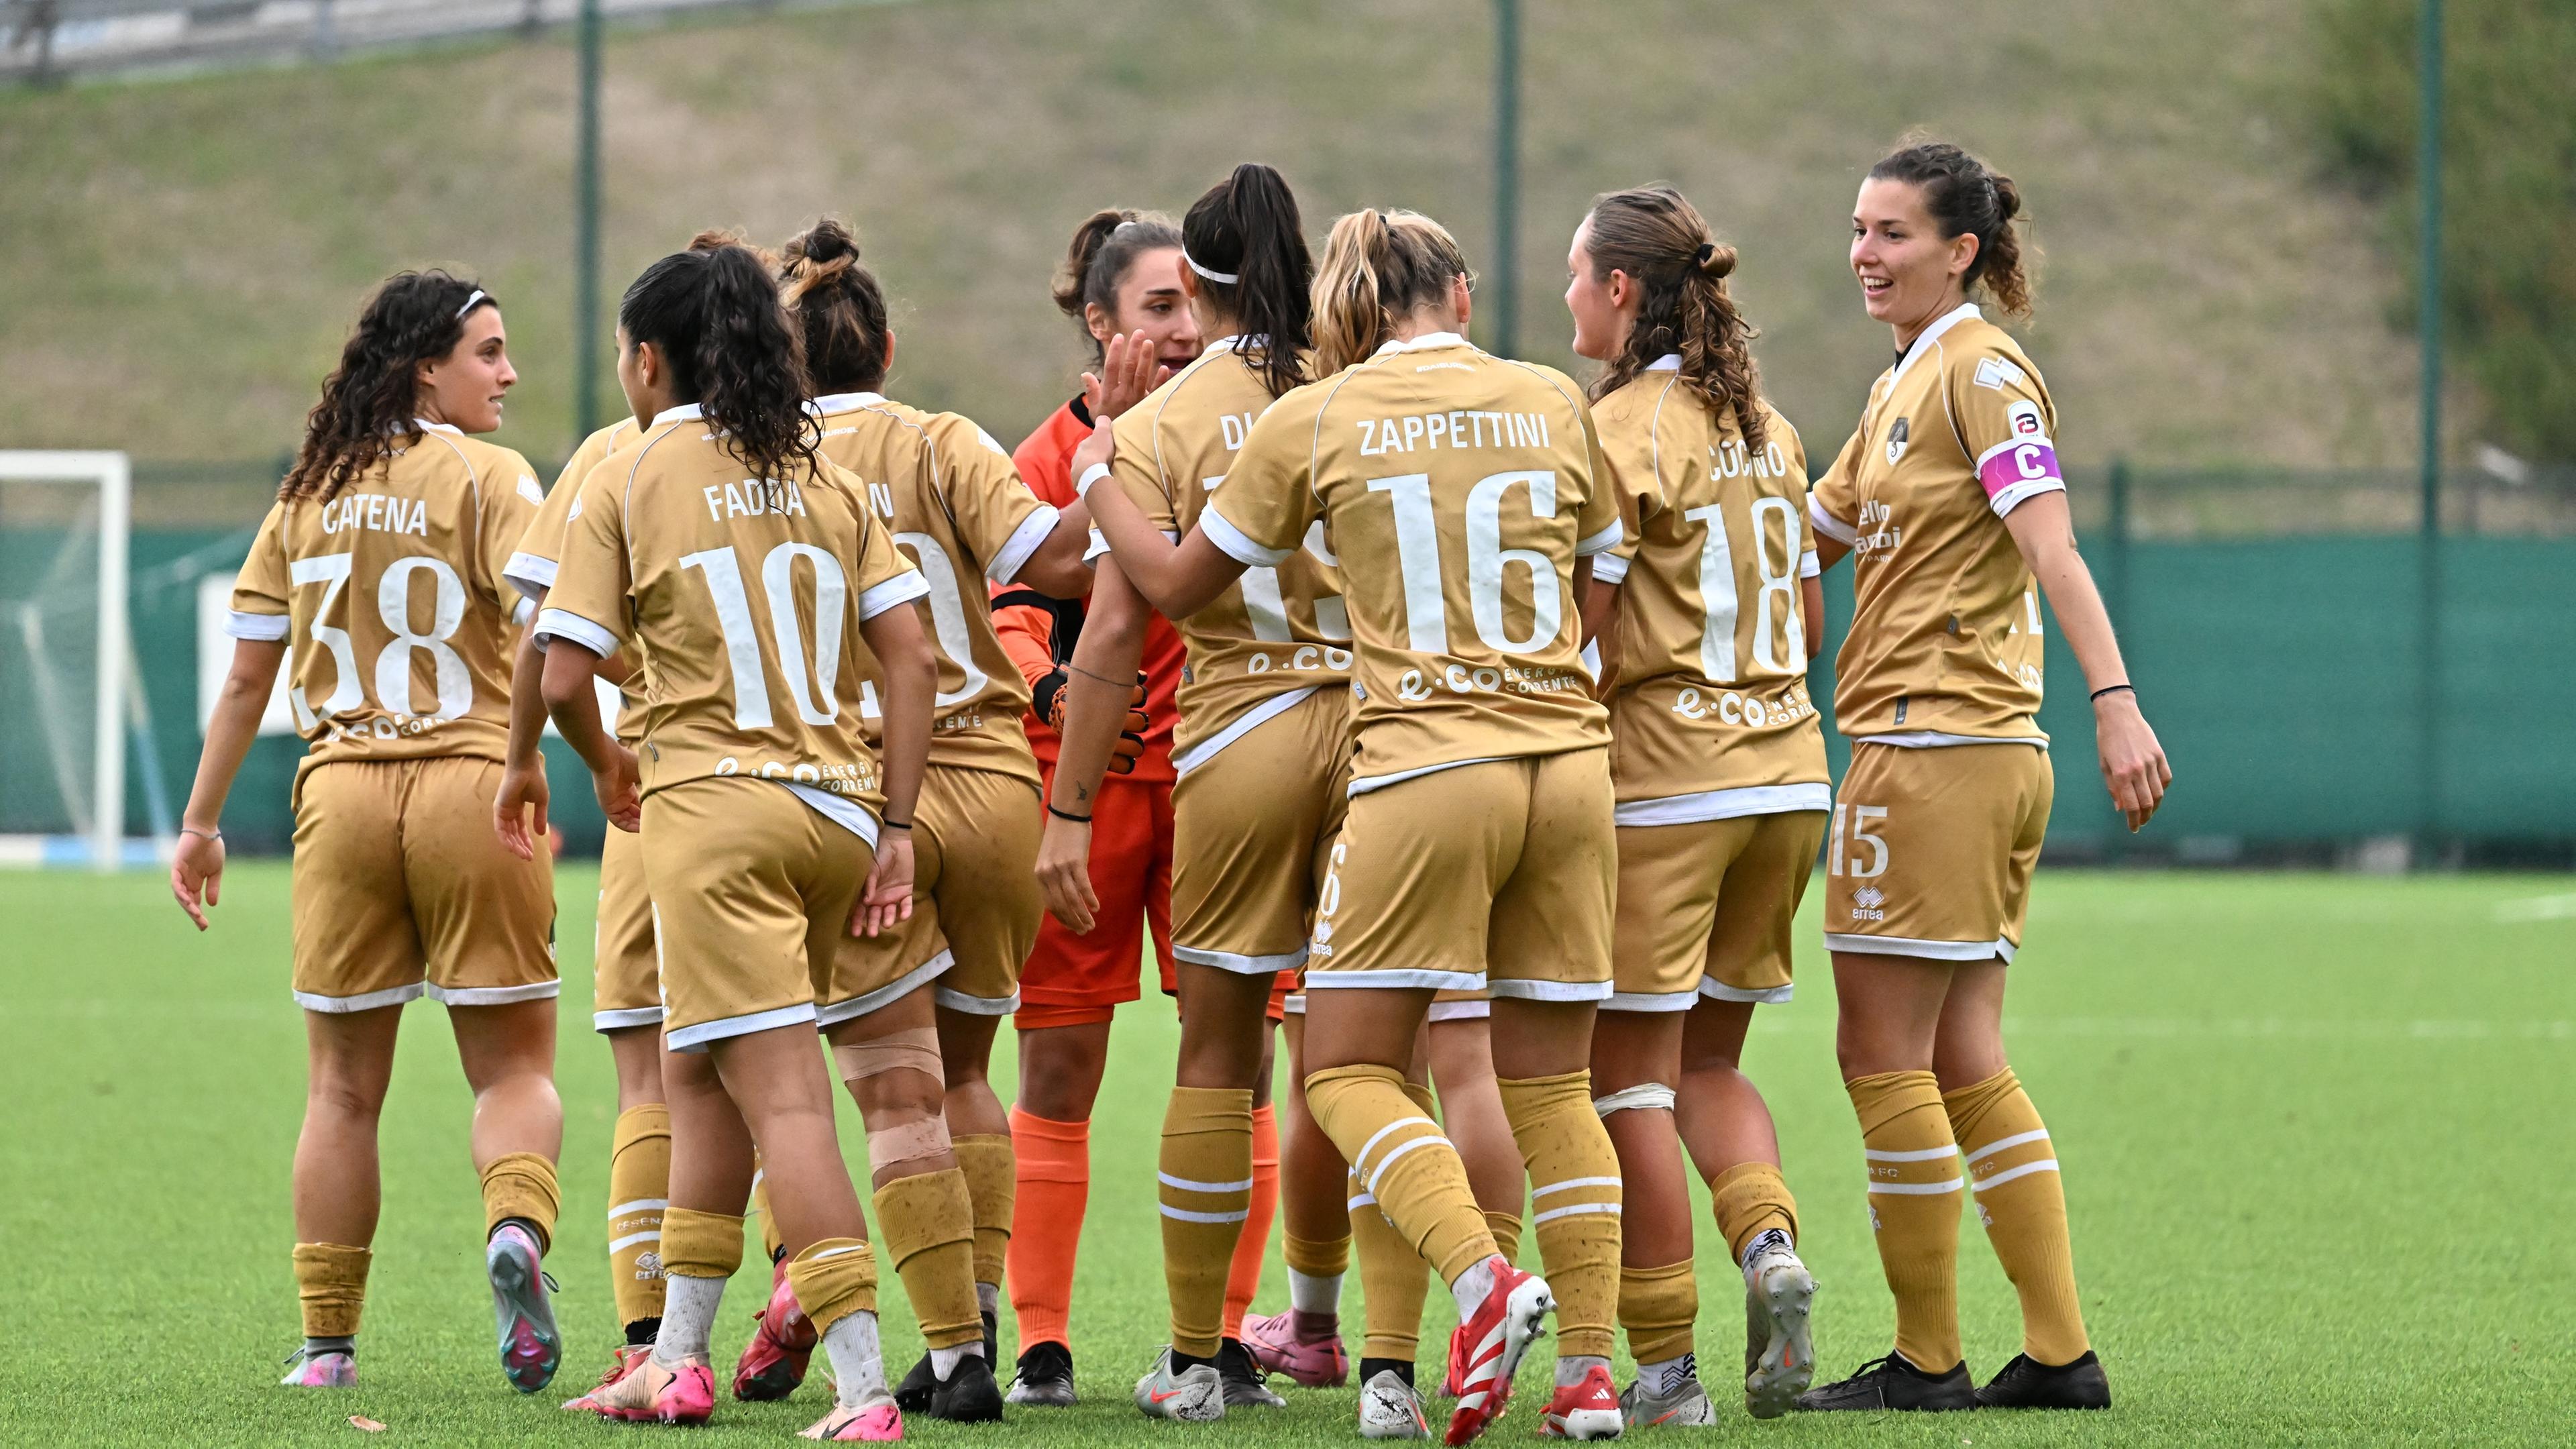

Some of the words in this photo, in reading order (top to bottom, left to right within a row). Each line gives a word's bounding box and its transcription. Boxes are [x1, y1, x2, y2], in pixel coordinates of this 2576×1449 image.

[1356, 411, 1550, 455] ZAPPETTINI
[2015, 444, 2046, 480] C
[322, 494, 427, 536] CATENA
[703, 478, 806, 521] FADDA
[1366, 470, 1560, 655] 16
[1684, 497, 1807, 682] 18
[290, 552, 473, 731] 38
[678, 541, 845, 731] 10
[1831, 804, 1889, 877] 15
[617, 1217, 662, 1232] CESEN
